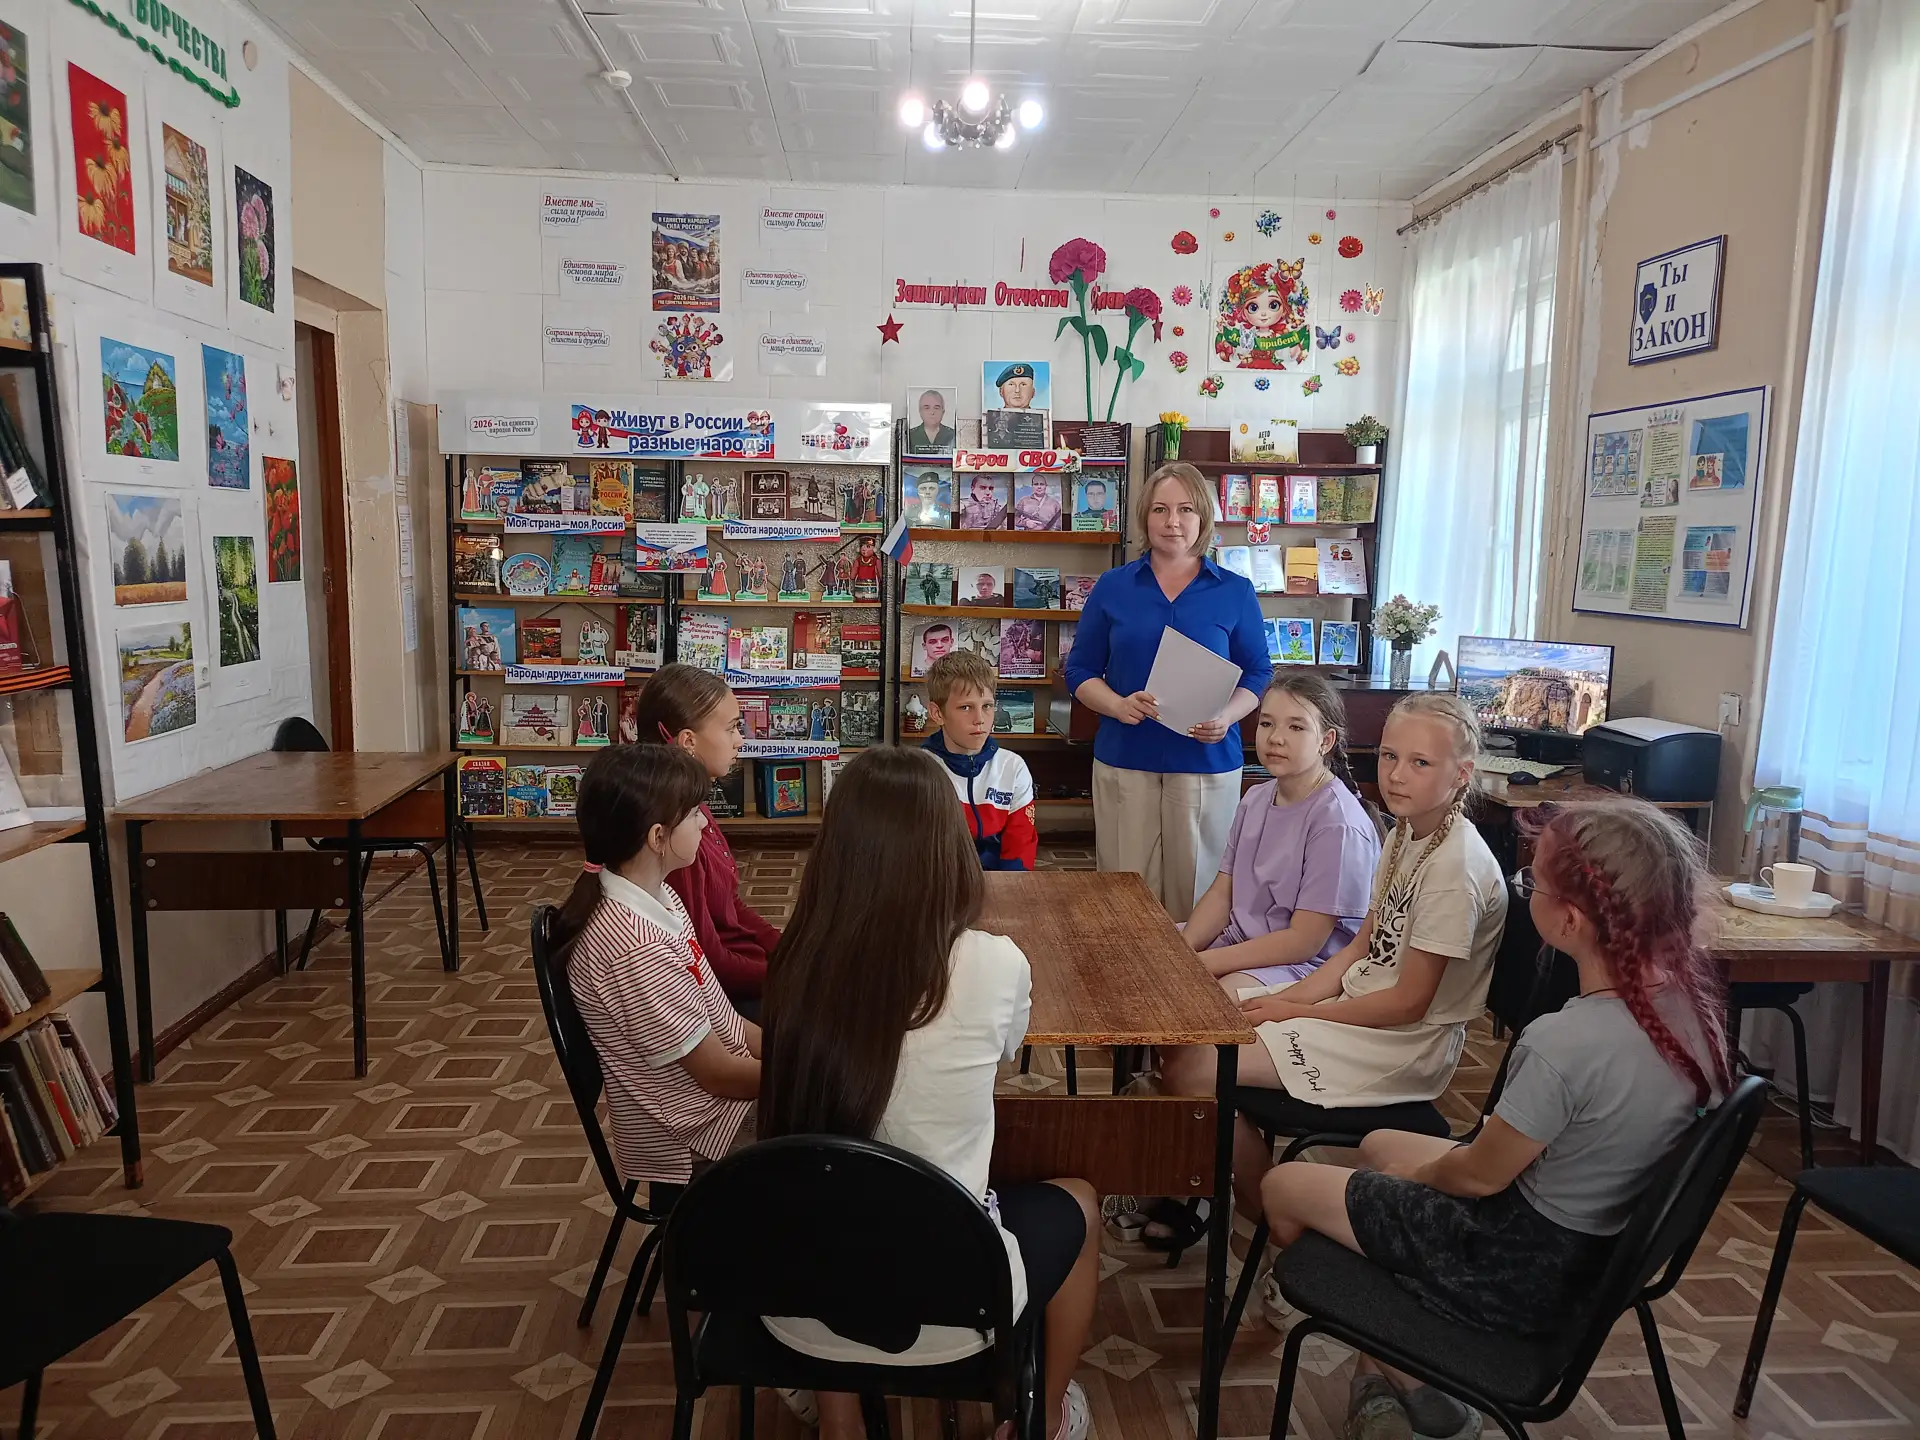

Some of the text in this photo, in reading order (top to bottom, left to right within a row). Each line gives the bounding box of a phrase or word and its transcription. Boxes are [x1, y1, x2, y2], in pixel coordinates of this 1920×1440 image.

[131, 0, 228, 82] ВОРЧЕСТВА
[544, 195, 578, 207] Вместе
[579, 199, 594, 208] мы
[550, 207, 568, 215] сила
[576, 207, 605, 218] правда
[763, 209, 824, 221] Вместе строим
[544, 215, 580, 224] народа!
[766, 218, 824, 229] сильную Россию!
[563, 260, 595, 270] Единство
[596, 263, 618, 272] нации
[566, 268, 614, 278] основа мира
[745, 270, 773, 280] Единство
[1660, 261, 1688, 288] Ты
[581, 276, 621, 284] согласия!
[749, 278, 769, 286] ключ
[776, 278, 806, 289] успеху!
[895, 278, 1128, 312] Защитникам Отечества Слав
[1665, 293, 1676, 312] и
[1635, 311, 1707, 351] ЗАКОН
[1260, 334, 1300, 350] привет!
[473, 419, 493, 429] 2026
[610, 410, 743, 431] Живут в России
[1258, 430, 1271, 440] ЛЕТО
[628, 435, 771, 458] разные народы
[1255, 442, 1276, 453] КНИГОЙ
[955, 450, 1057, 468] Герои СВО
[506, 516, 528, 529] Моя
[529, 519, 561, 530] страна
[570, 519, 590, 531] моя
[591, 518, 624, 531] Россия
[724, 523, 840, 538] Красота народного костюма
[589, 584, 619, 592] РОССИЯ
[507, 667, 624, 682] Народы дружат книгами
[726, 673, 839, 687] Игры, традиции, праздники
[738, 745, 838, 757] азки разных народов
[1282, 1030, 1326, 1093] Preppy Pink
